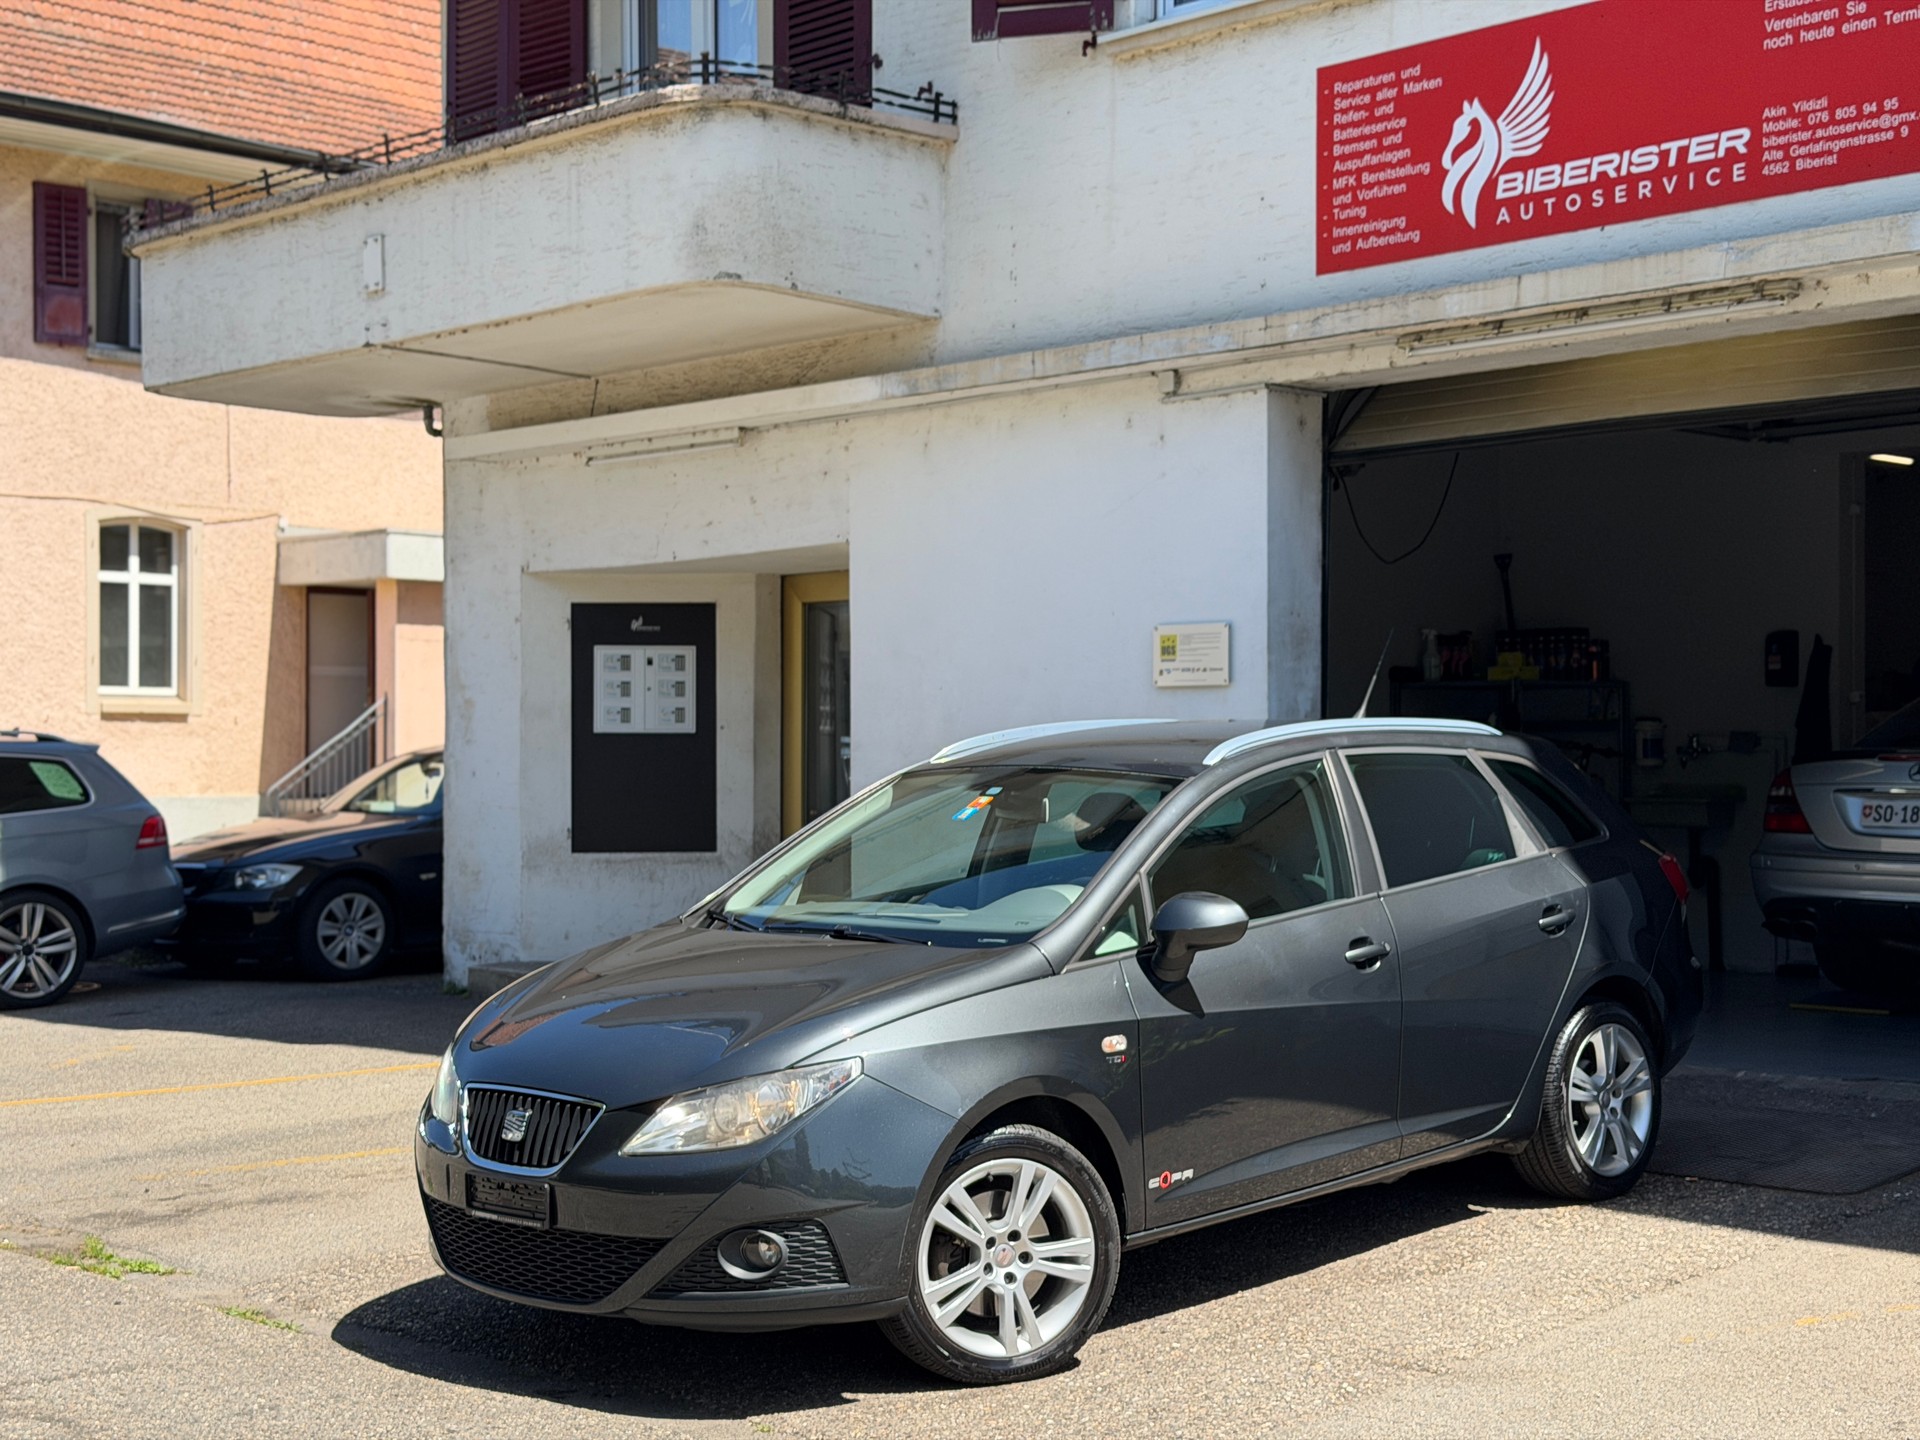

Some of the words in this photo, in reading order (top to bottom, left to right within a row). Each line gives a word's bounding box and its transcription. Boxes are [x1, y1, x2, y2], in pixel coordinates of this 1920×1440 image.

[1764, 7, 1839, 33] Vereinbaren
[1846, 1, 1867, 16] Sie
[1763, 33, 1793, 50] noch
[1800, 25, 1835, 43] heute
[1842, 17, 1877, 34] einen
[1333, 71, 1396, 95] Reparaturen
[1400, 64, 1421, 79] und
[1333, 94, 1371, 110] Service
[1376, 87, 1398, 101] aller
[1403, 77, 1443, 95] Marken
[1333, 109, 1369, 125] Reifen-
[1374, 102, 1394, 116] und
[1762, 106, 1787, 119] Akin
[1762, 118, 1802, 134] Mobile:
[1808, 111, 1829, 125] 076
[1835, 105, 1857, 120] 805
[1863, 102, 1877, 115] 94
[1883, 97, 1899, 111] 95
[1333, 117, 1407, 142] Batterieservice
[1762, 111, 1920, 148] biberister.autoservice@gmx.
[1333, 139, 1377, 157] Bremsen
[1382, 130, 1402, 146] und
[1762, 150, 1784, 162] Alte
[1900, 125, 1909, 137] 9
[1333, 148, 1411, 173] Auspuffanlagen
[1495, 127, 1751, 200] BIBERISTER
[1762, 161, 1790, 176] 4562
[1795, 153, 1838, 171] Biberist
[1333, 175, 1356, 190] MFK
[1361, 162, 1431, 185] Bereitstellung
[1333, 191, 1352, 206] und
[1496, 162, 1747, 225] AUTOSERVICE
[1332, 206, 1367, 220] Tuning
[1332, 216, 1406, 238] Innenreinigung
[1332, 240, 1351, 255] und
[1356, 230, 1420, 250] Aufbereitung
[1148, 1169, 1194, 1190] COPA
